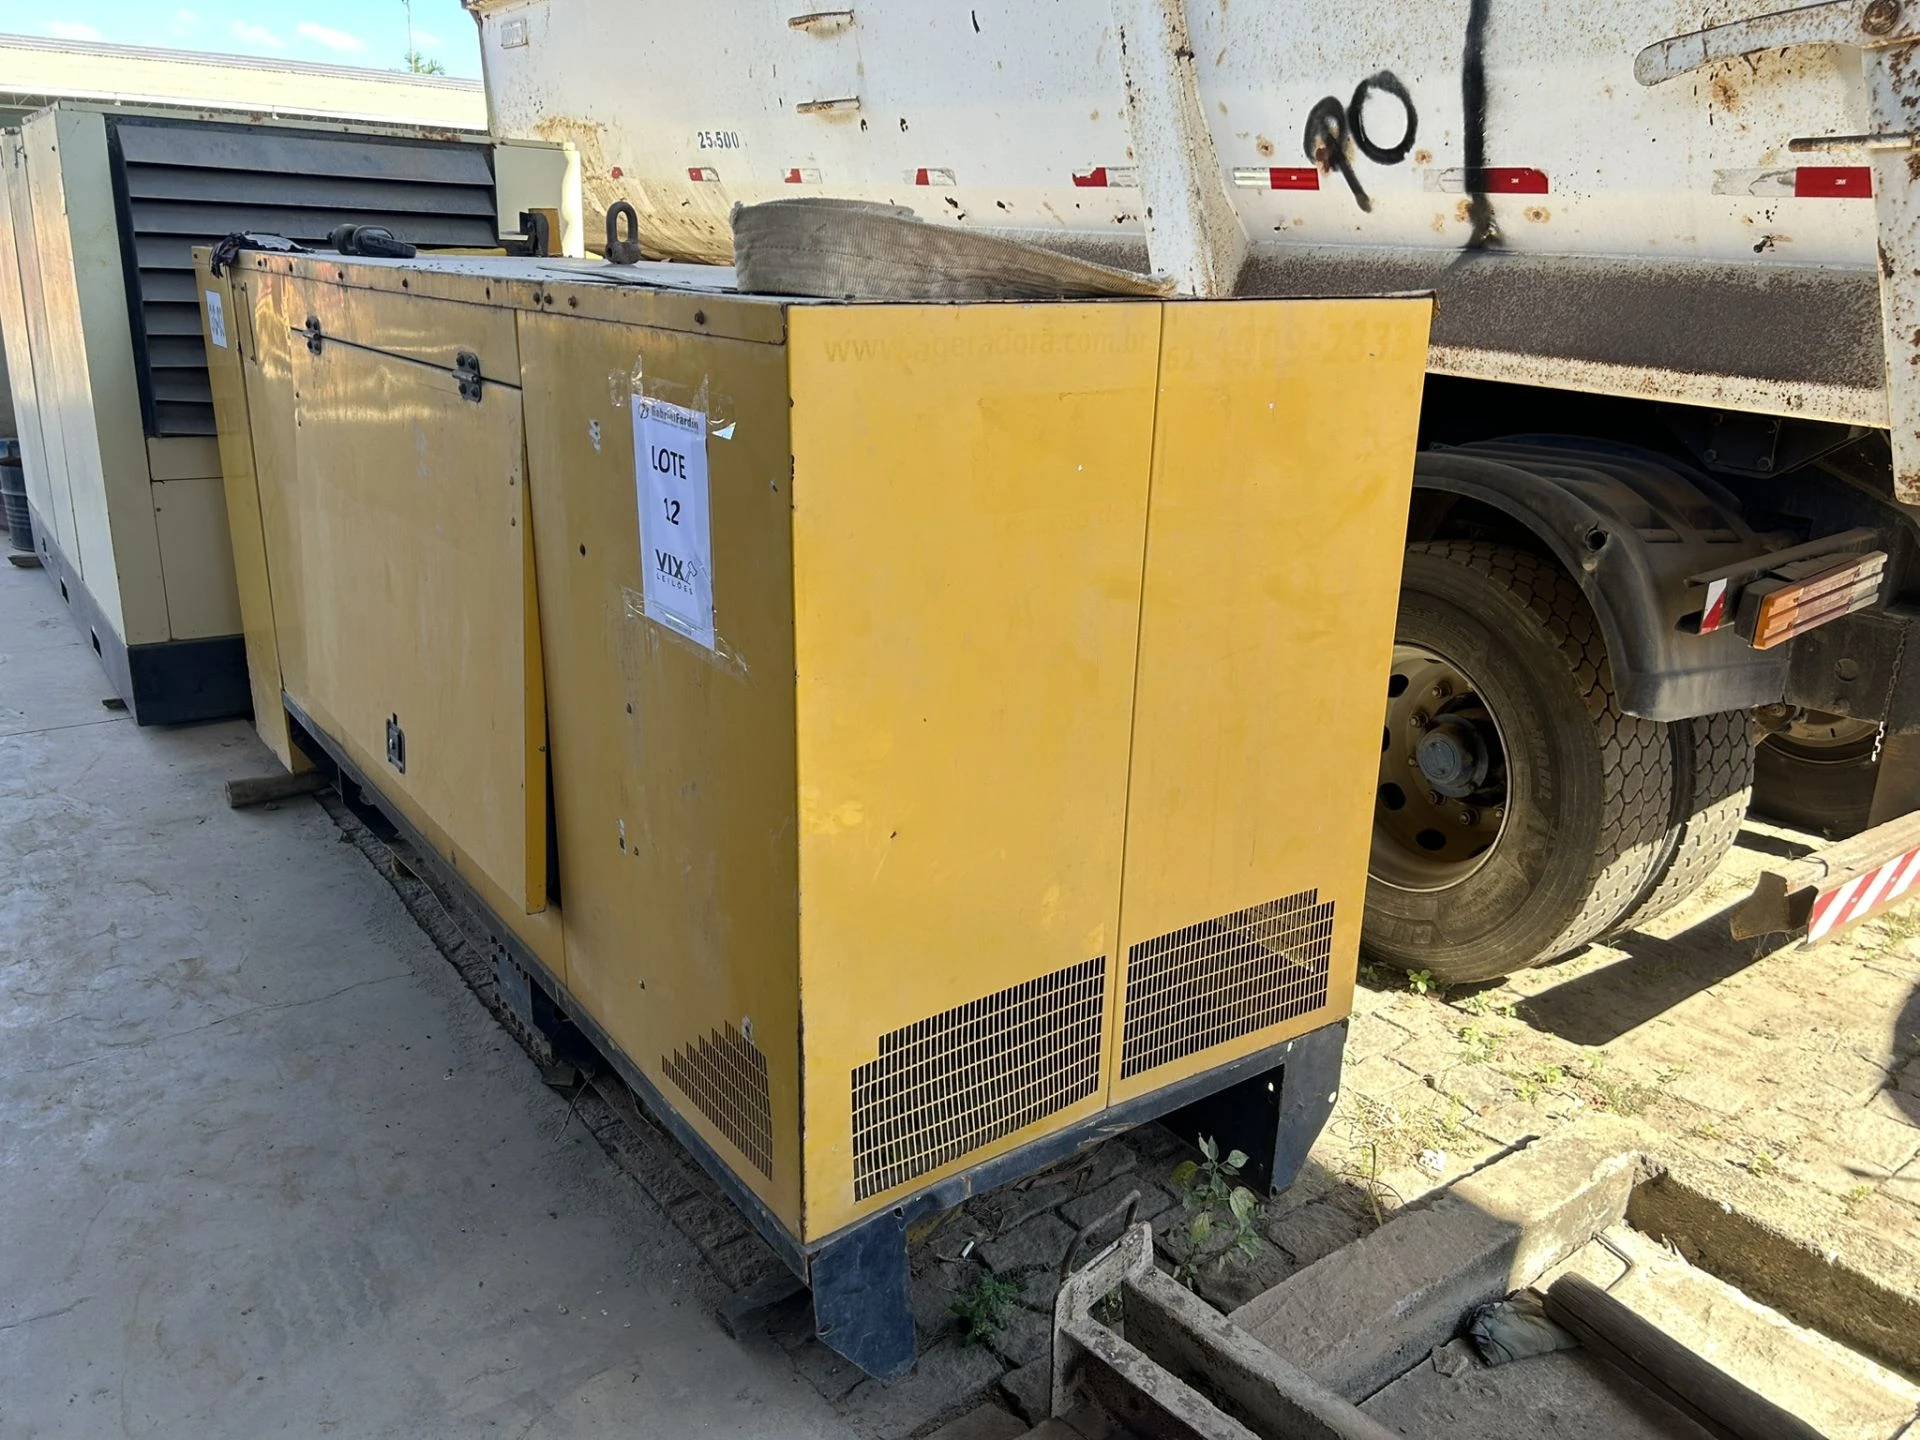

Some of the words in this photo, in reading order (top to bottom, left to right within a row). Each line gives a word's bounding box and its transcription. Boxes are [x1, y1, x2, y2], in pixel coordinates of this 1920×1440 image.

[697, 131, 740, 149] 25.500
[1834, 178, 1847, 186] 3M
[651, 445, 687, 480] LOTE
[663, 497, 681, 526] 12
[655, 548, 684, 581] VIX
